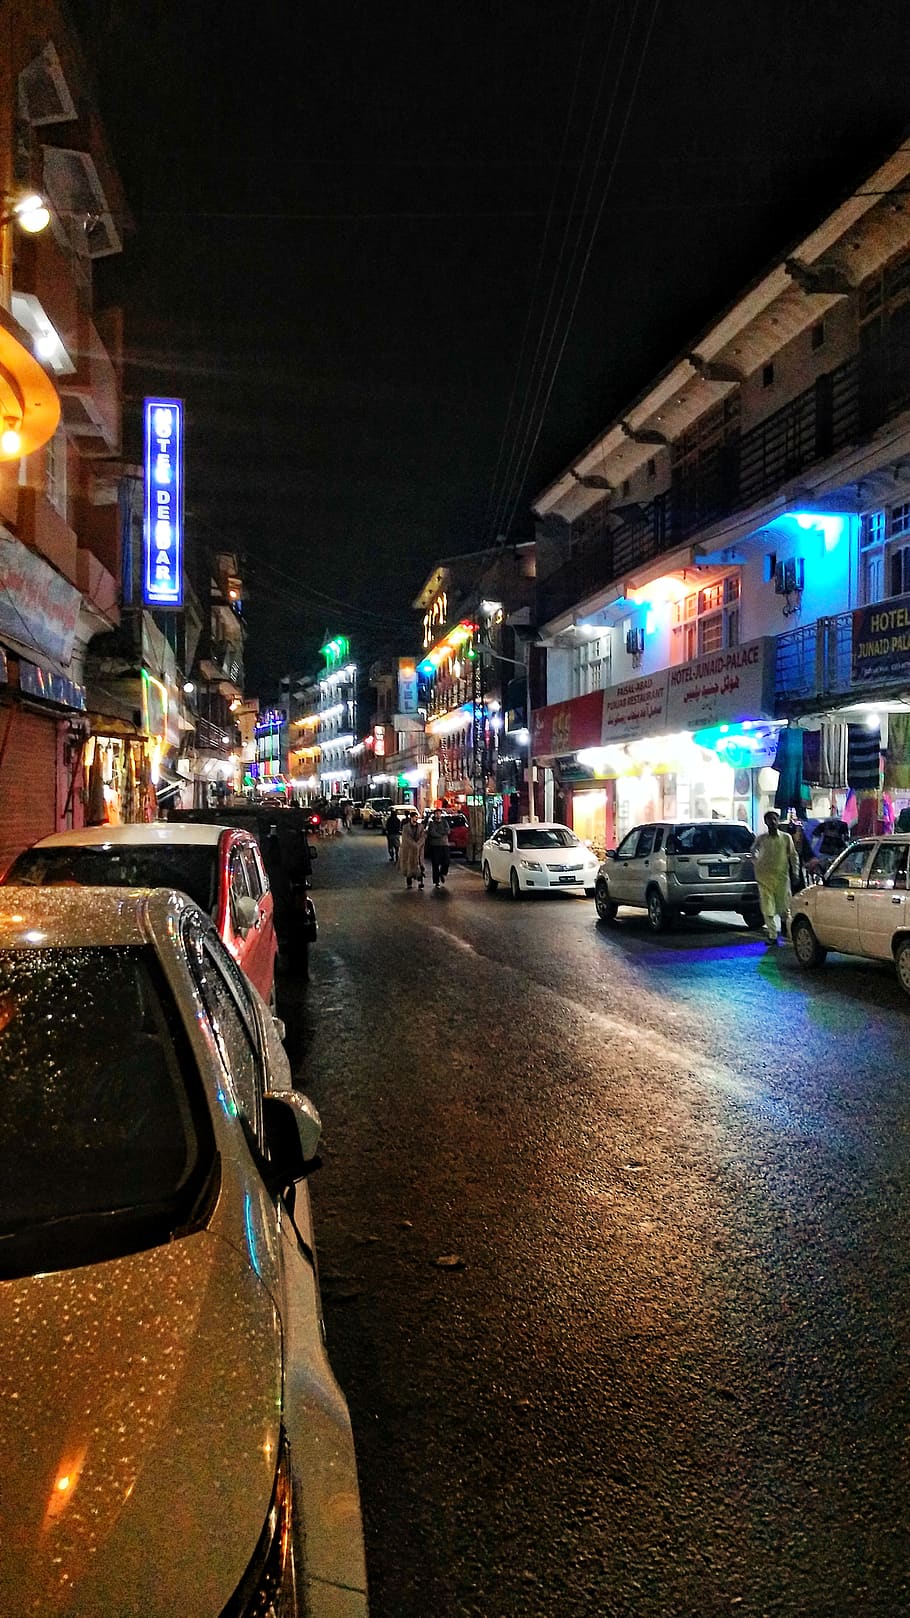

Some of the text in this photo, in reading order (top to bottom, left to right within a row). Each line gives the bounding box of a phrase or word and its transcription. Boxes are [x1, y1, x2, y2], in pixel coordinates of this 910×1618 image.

[154, 408, 173, 484] HOTEL
[871, 608, 910, 632] HOTEL
[857, 638, 889, 658] JUNAID
